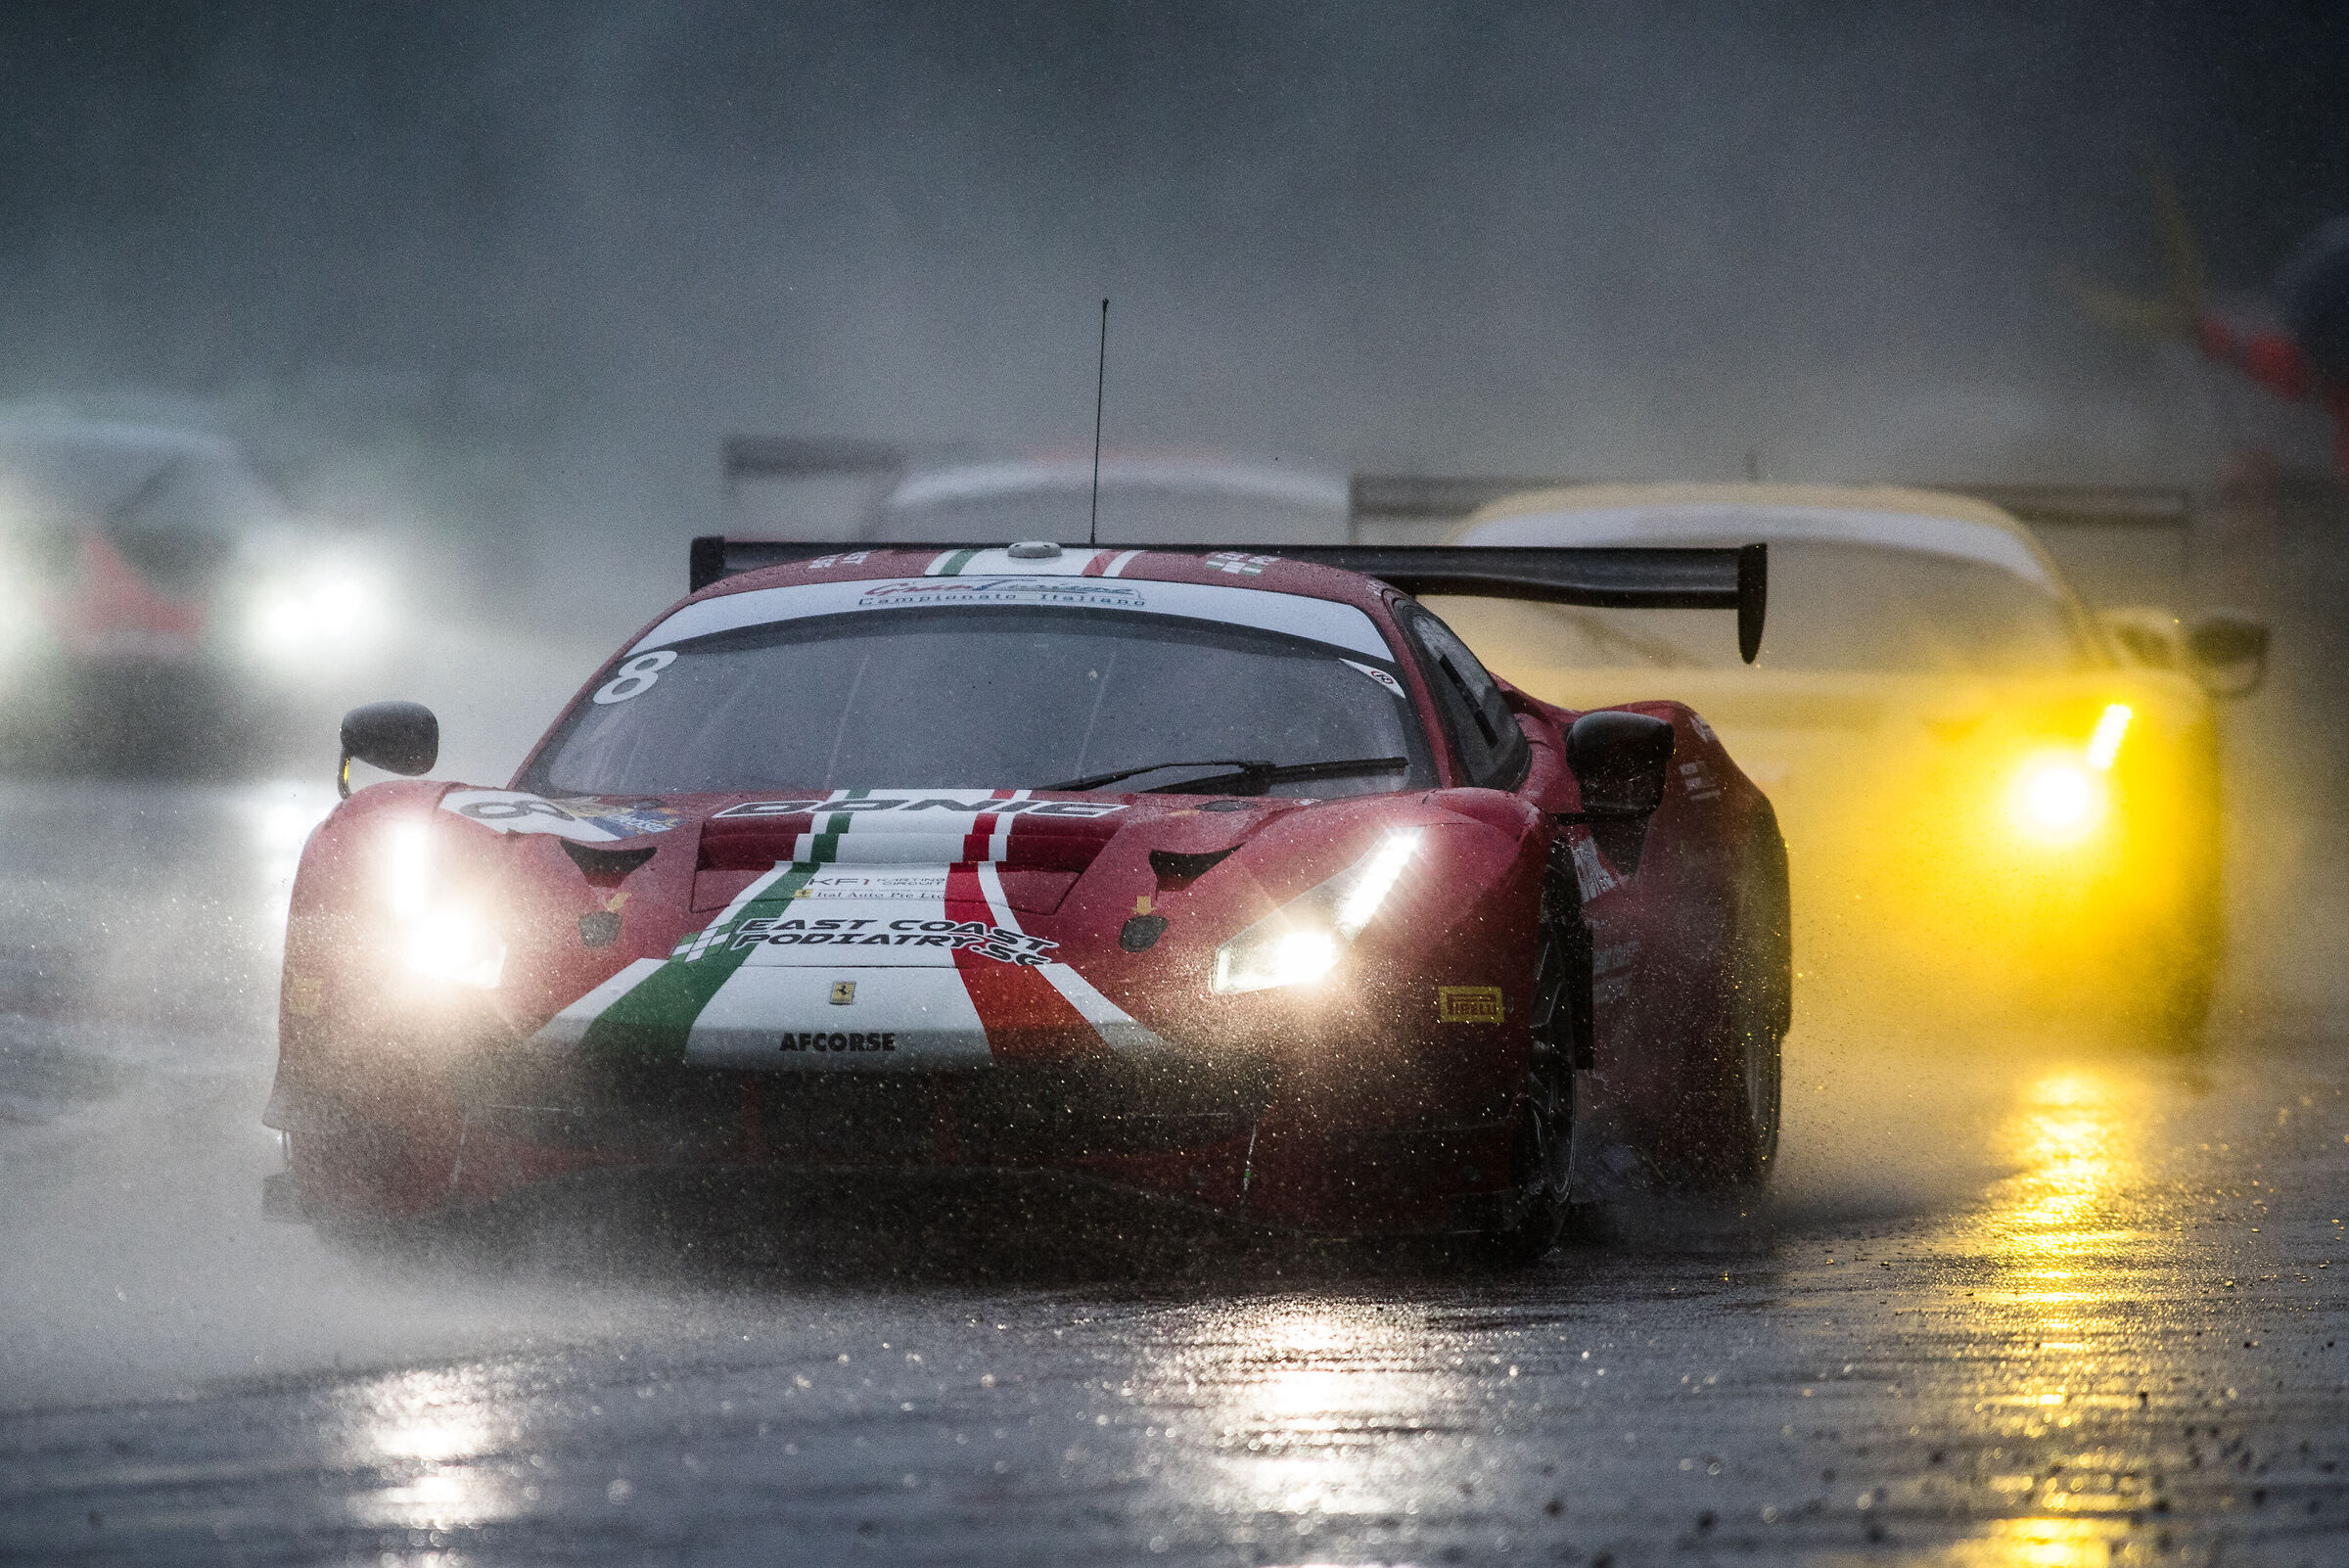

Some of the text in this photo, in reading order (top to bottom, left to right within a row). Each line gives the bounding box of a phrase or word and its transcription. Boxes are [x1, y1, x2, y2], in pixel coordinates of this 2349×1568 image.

[859, 594, 1145, 606] Campionato Italiano
[592, 650, 677, 705] 8
[459, 800, 576, 822] 8
[712, 799, 1130, 818] DONIC
[736, 918, 1060, 950] EAST COAST
[1446, 993, 1497, 1016] PIRELLI
[779, 1033, 896, 1052] AFCORSE
